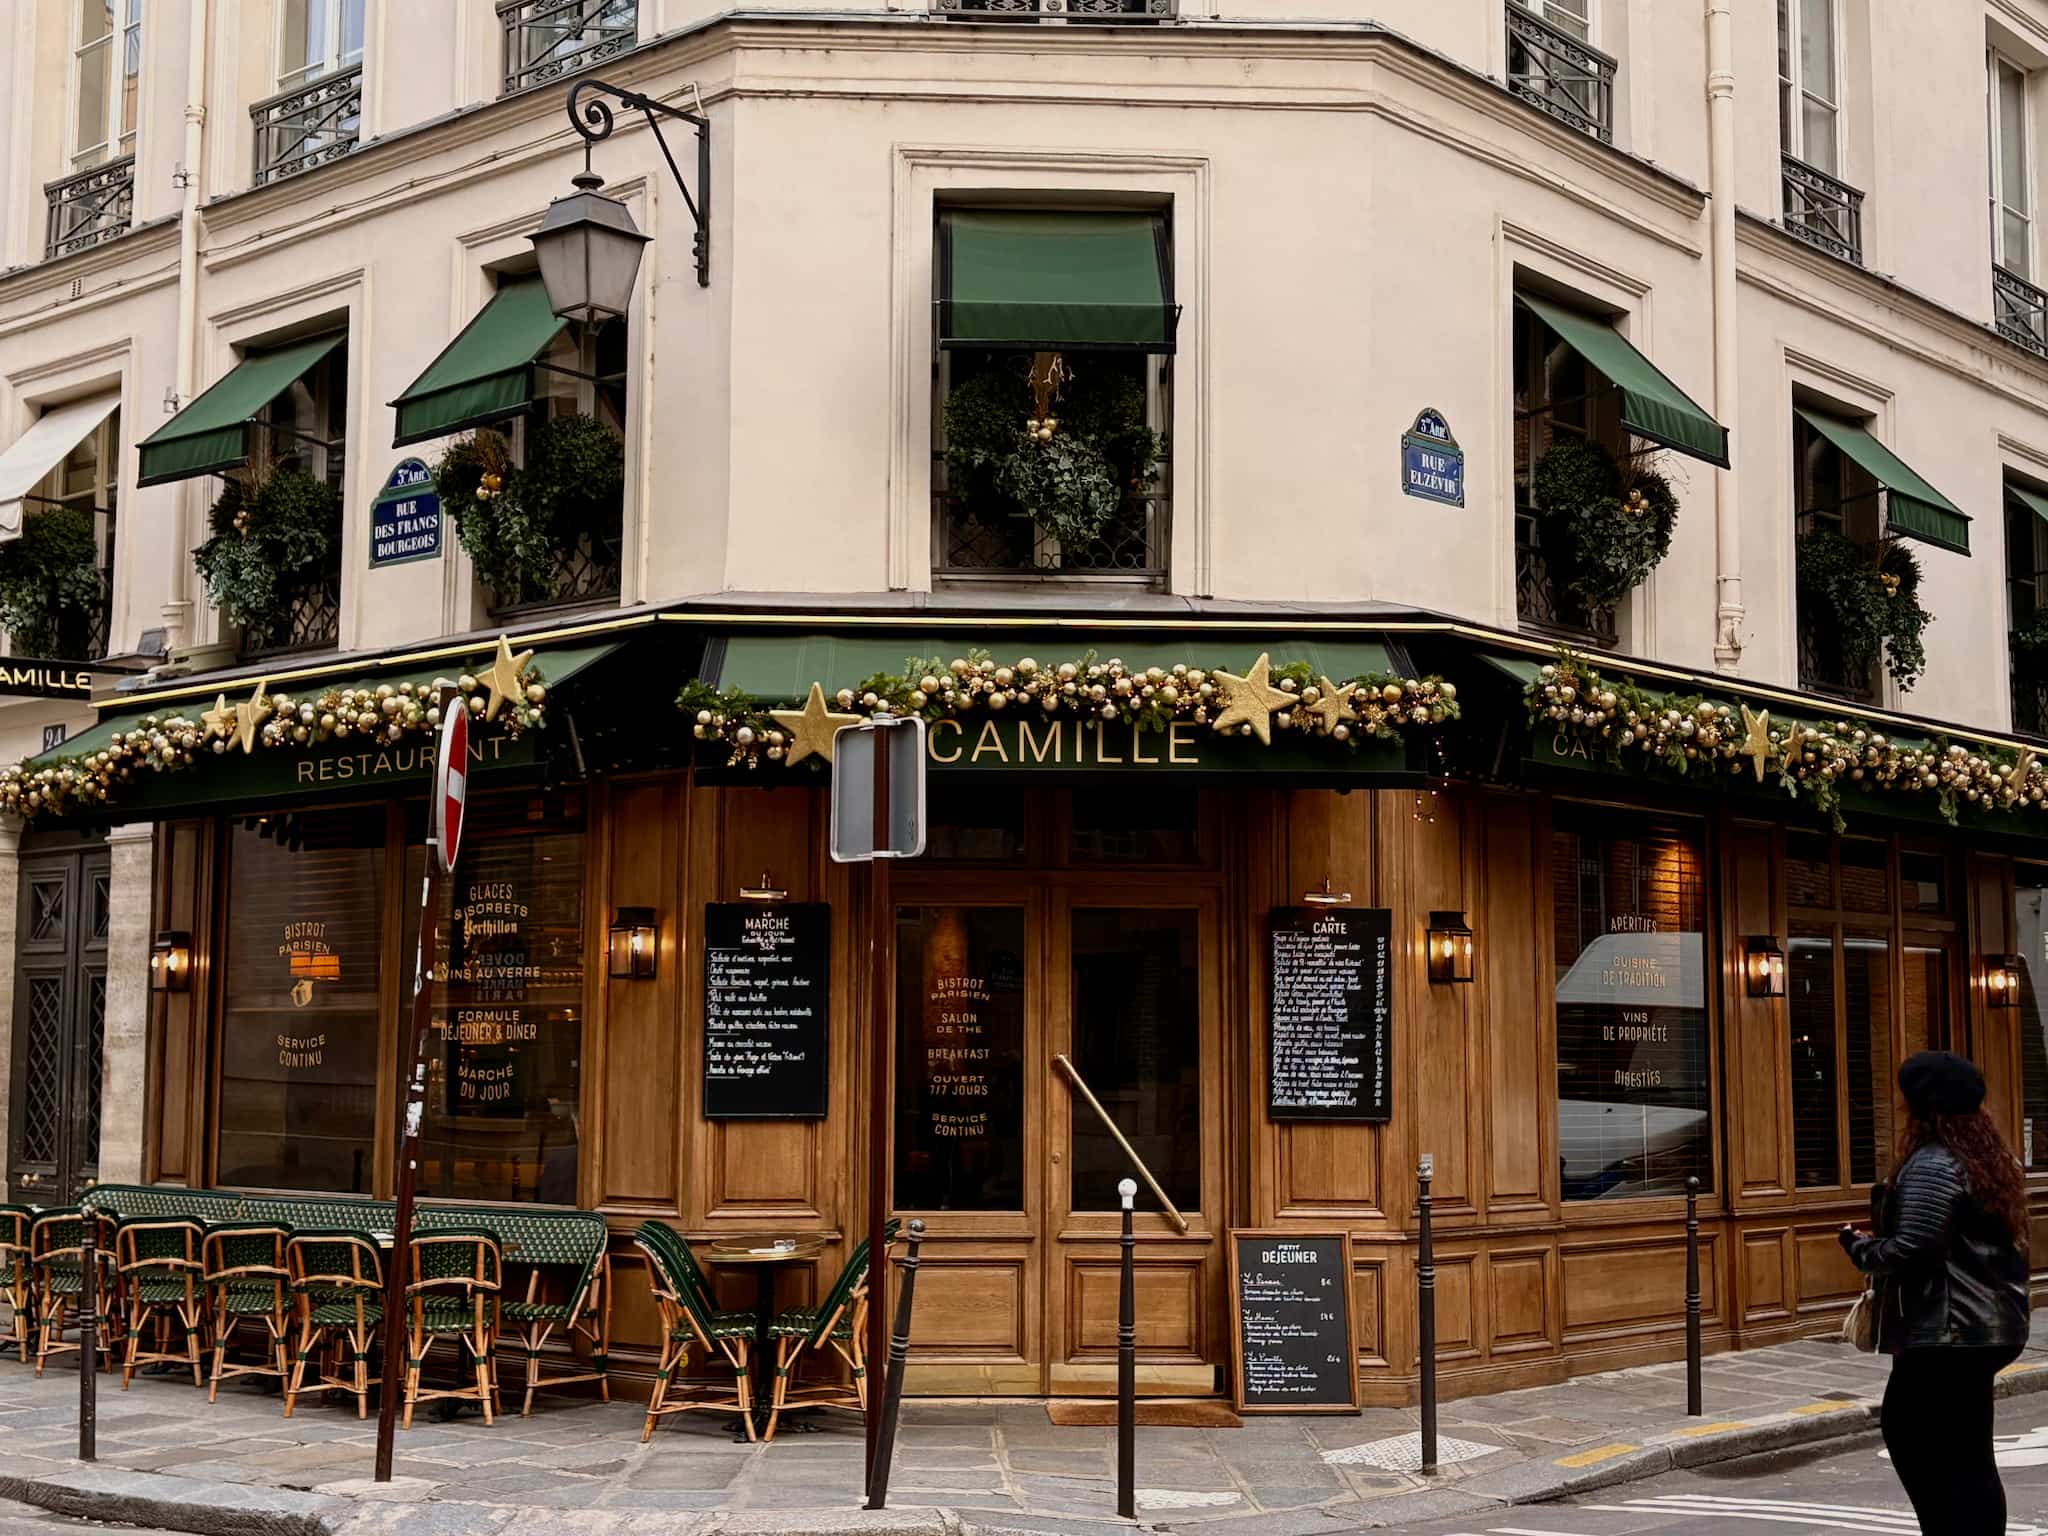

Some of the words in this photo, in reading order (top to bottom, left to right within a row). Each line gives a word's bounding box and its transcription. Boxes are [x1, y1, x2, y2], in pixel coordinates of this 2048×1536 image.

[1422, 453, 1445, 472] RUE
[396, 500, 417, 517] RUE
[375, 523, 394, 539] DES
[398, 515, 438, 535] FRANCS
[378, 533, 435, 557] BOURGEOIS
[45, 728, 62, 751] 24
[928, 721, 1200, 764] CAMILLE
[298, 736, 507, 783] RESTAURNT
[470, 883, 513, 901] GLACES
[467, 902, 529, 918] SORBETS
[285, 922, 326, 941] BISTROT
[1313, 922, 1347, 935] CARTE
[279, 941, 331, 957] PARISIEN
[1614, 956, 1657, 968] CUISINE
[442, 967, 471, 979] VINS
[477, 967, 493, 979] AU
[497, 966, 541, 978] VERRE
[1602, 970, 1614, 985] DE
[1616, 970, 1665, 988] TRADITION
[937, 978, 985, 991] BISTROT
[931, 990, 991, 1001] PARISIEN
[458, 1009, 520, 1022] FORMULE
[942, 1013, 977, 1024] SALON
[1622, 1012, 1649, 1024] VINS
[495, 1024, 502, 1040] &
[936, 1025, 953, 1033] DE
[1603, 1025, 1616, 1041] DE
[277, 1034, 326, 1049] SERVICE
[280, 1049, 322, 1068] CONTINU
[928, 1049, 991, 1060] BREAKFAST
[933, 1075, 985, 1083] OUVERT
[1615, 1069, 1660, 1087] DIGESTIFS
[460, 1081, 476, 1099] DU
[480, 1081, 510, 1101] JOUR
[952, 1085, 988, 1096] JOURS
[932, 1113, 989, 1123] SERVICE
[934, 1124, 984, 1137] CONTINU
